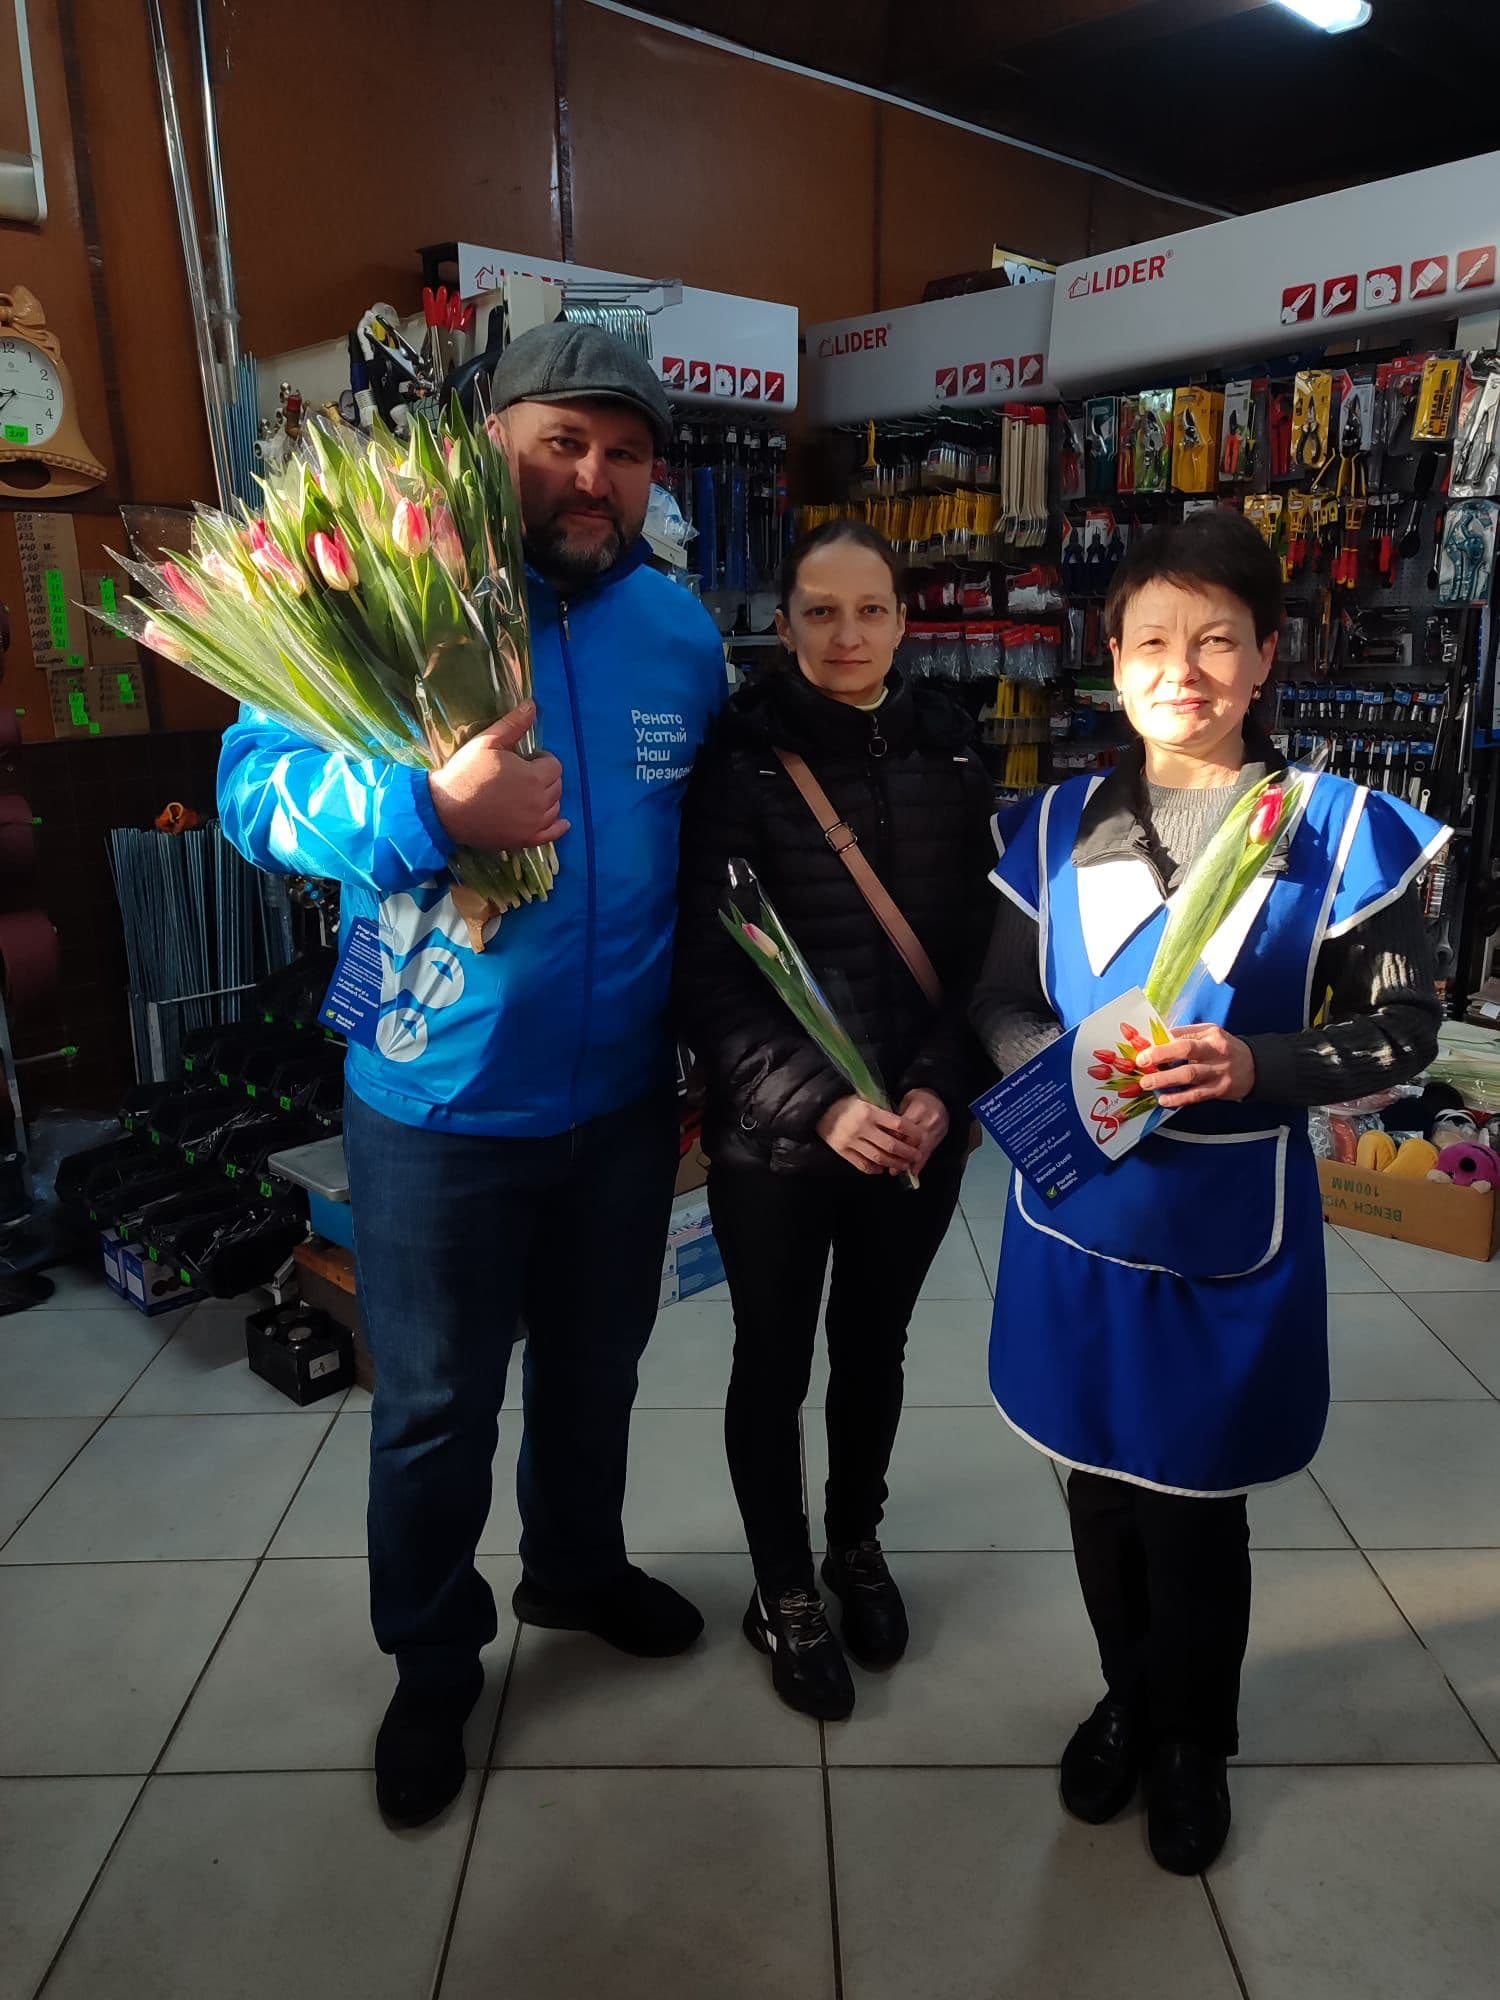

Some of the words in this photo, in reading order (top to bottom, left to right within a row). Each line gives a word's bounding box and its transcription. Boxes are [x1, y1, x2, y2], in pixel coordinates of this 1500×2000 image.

[1092, 255, 1166, 294] LIDER
[2, 341, 15, 354] 12
[835, 326, 888, 355] LIDER
[27, 351, 33, 363] 1
[40, 368, 49, 381] 2
[46, 388, 54, 401] 3
[45, 407, 53, 420] 4
[35, 423, 44, 436] 5
[631, 709, 683, 725] Ренато
[634, 727, 687, 743] Усатый
[636, 746, 671, 762] Наш
[1332, 1176, 1379, 1197] 100MM
[1354, 1199, 1403, 1222] BENCH
